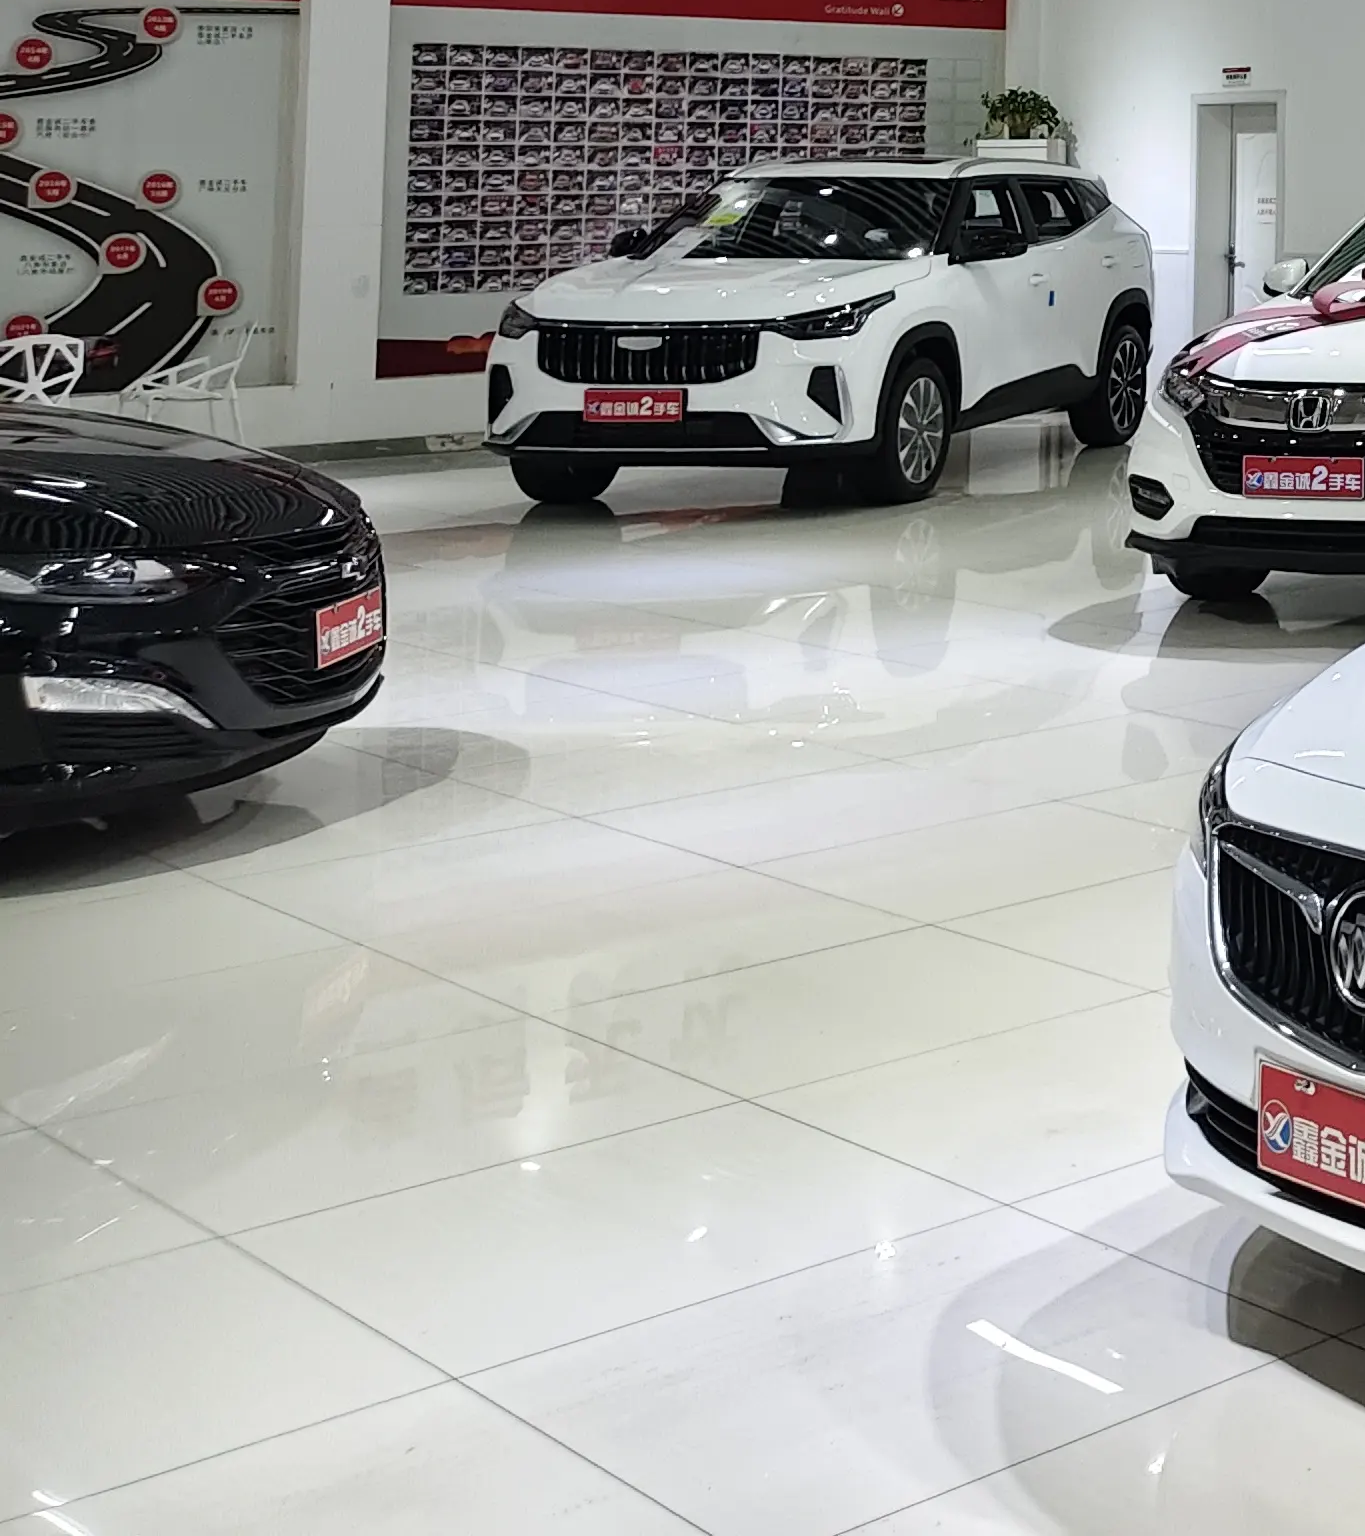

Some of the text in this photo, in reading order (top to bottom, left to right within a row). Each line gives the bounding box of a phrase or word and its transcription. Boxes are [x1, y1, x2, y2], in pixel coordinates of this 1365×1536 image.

[825, 4, 891, 16] Gratitude Wall
[1263, 465, 1362, 491] 鑫金诚2手车
[330, 605, 382, 652] 鑫金诚2手车
